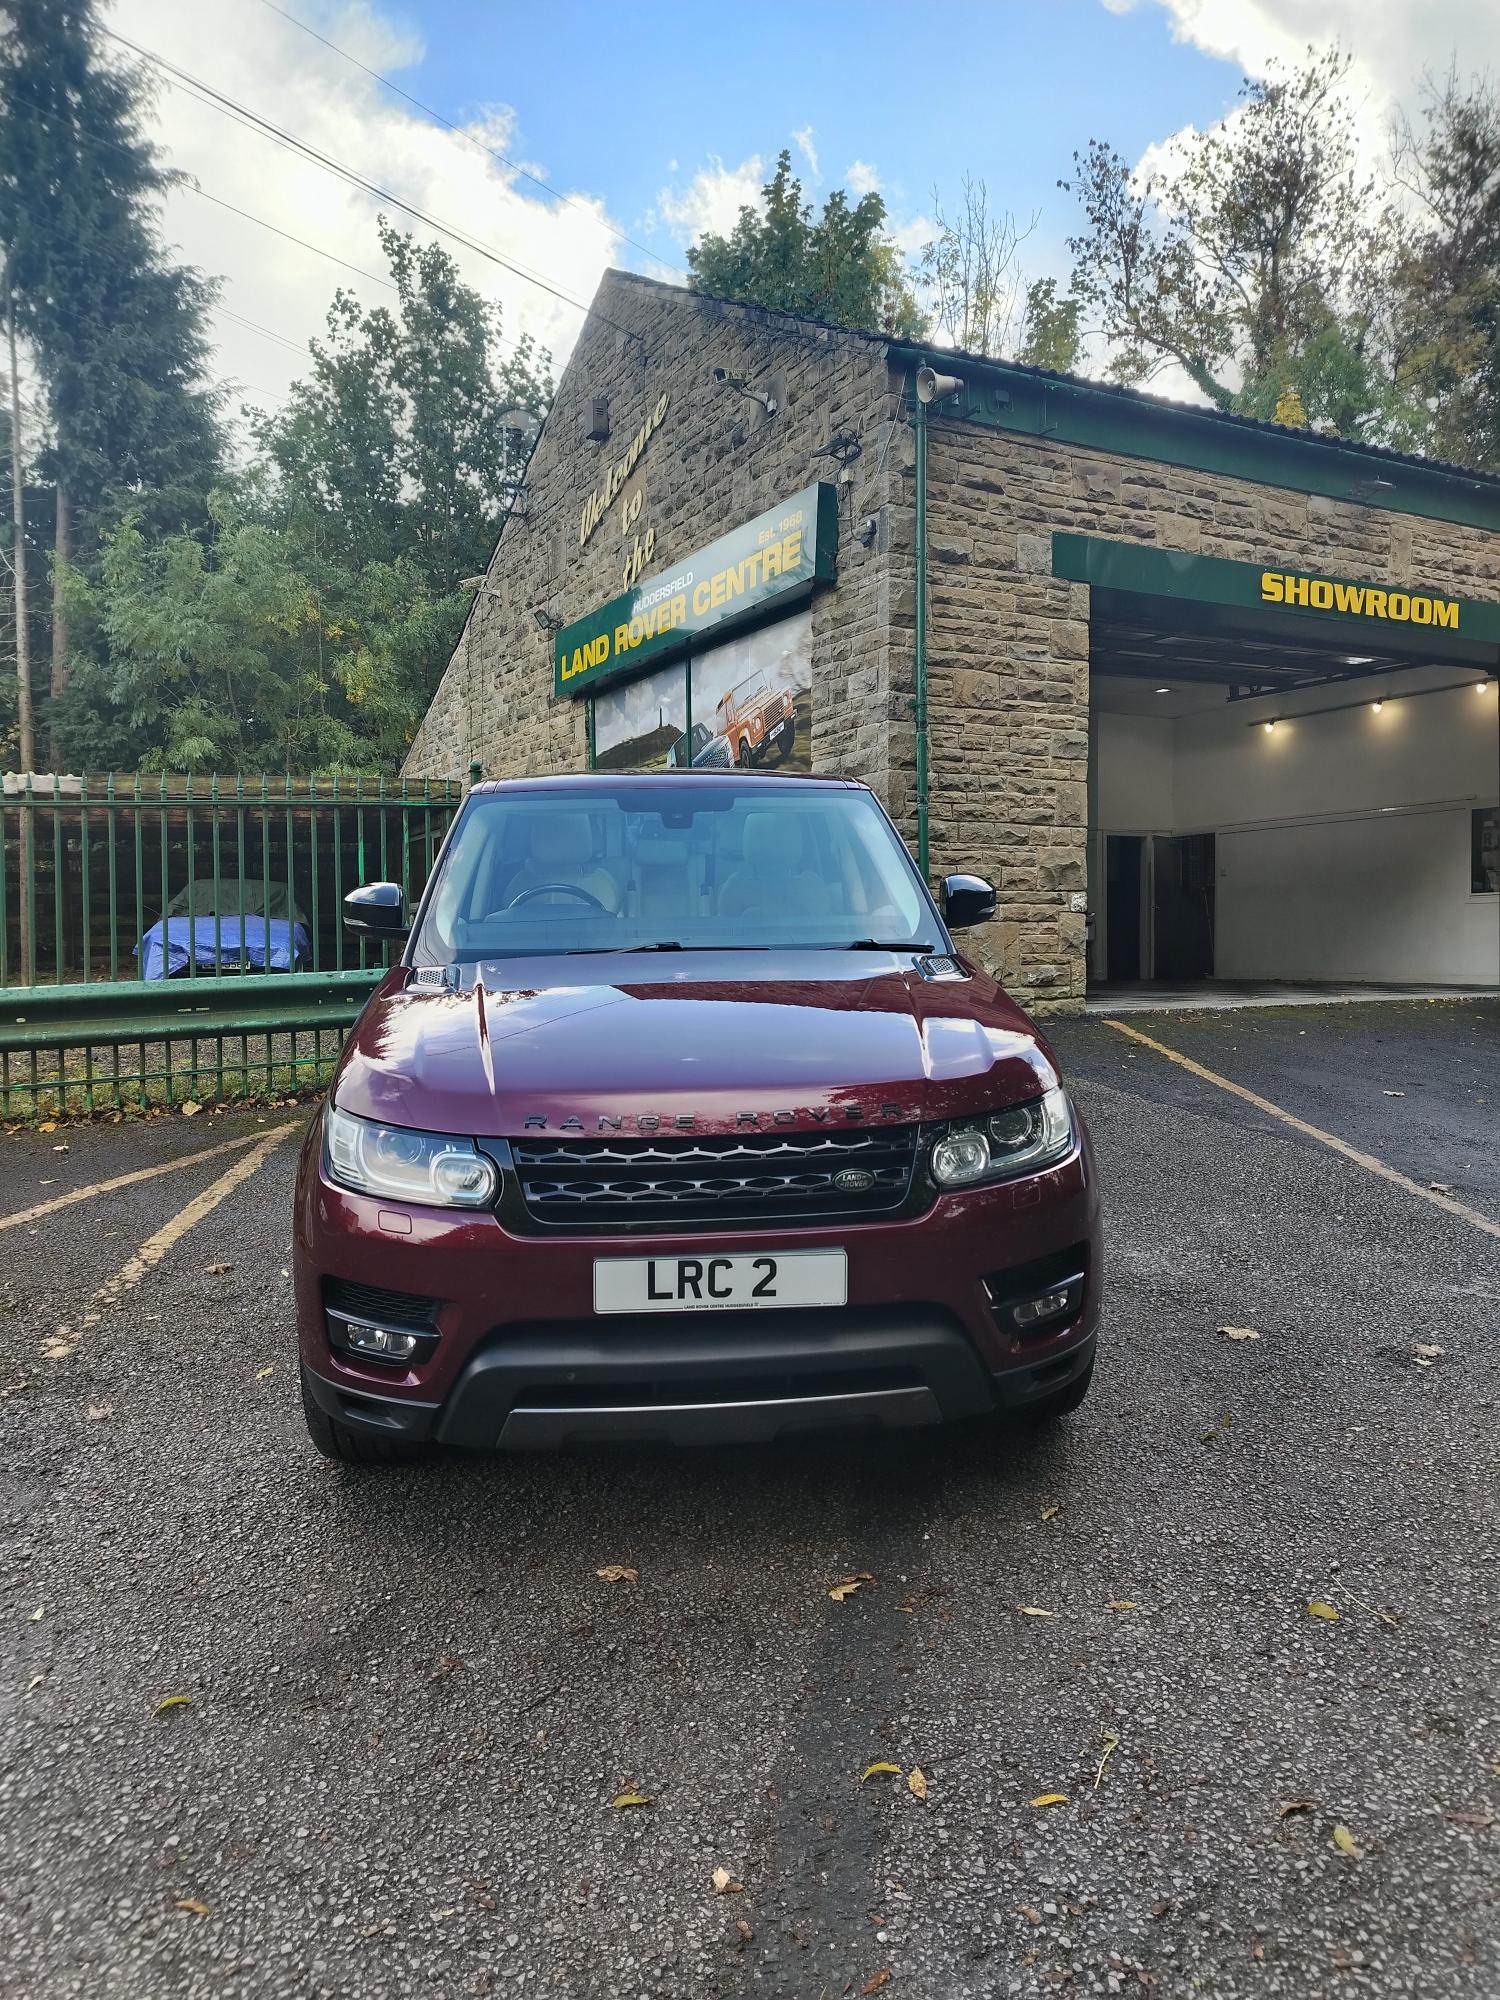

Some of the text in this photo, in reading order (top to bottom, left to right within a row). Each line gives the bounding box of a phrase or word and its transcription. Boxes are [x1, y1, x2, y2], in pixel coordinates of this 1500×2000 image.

[581, 392, 670, 546] Welcome
[622, 488, 642, 536] to
[622, 527, 656, 592] the
[561, 529, 802, 681] LAND ROVER CENTRE
[632, 571, 694, 614] HUDDERSFIELD
[1260, 571, 1461, 629] SHOWROOM
[523, 1101, 902, 1131] RANGE ROVER
[647, 1257, 777, 1300] LRC 2
